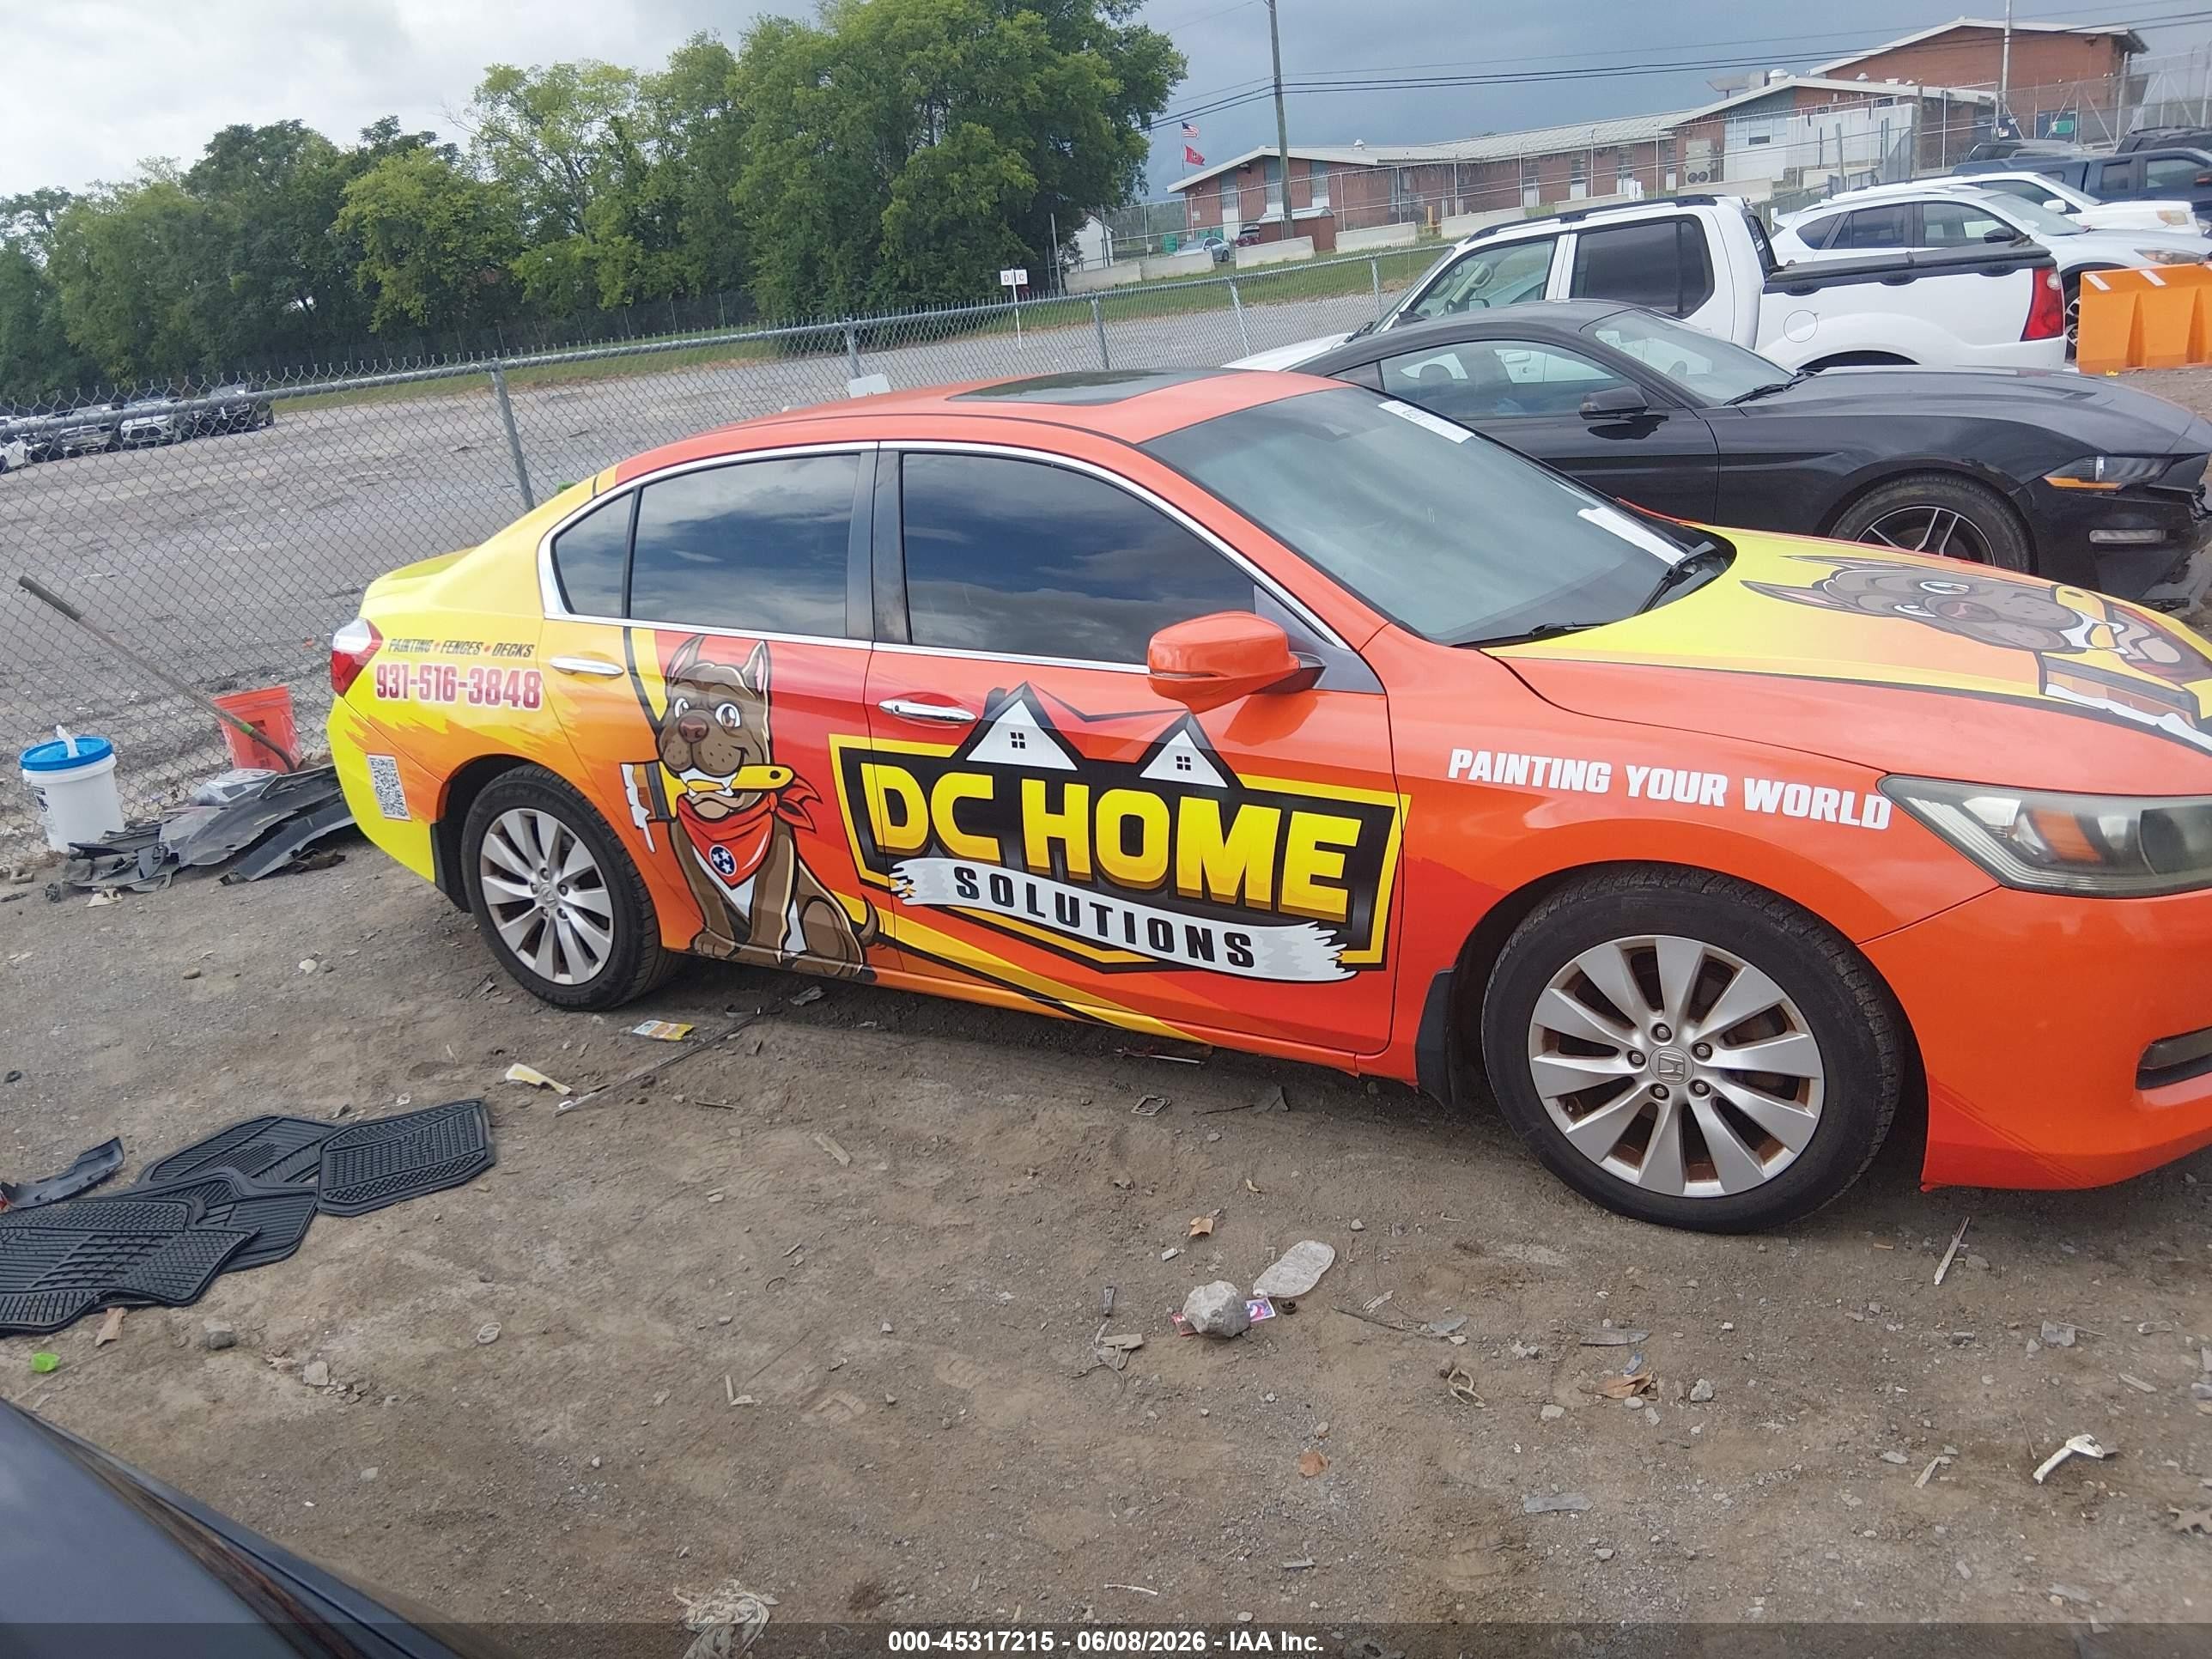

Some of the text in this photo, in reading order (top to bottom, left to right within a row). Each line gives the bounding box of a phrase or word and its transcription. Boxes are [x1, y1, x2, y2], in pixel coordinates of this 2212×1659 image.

[375, 664, 542, 710] 931-516-3848
[387, 638, 535, 659] PAINTING FENCES DECKS
[1447, 748, 1893, 830] PAINTING YOUR WORLD
[860, 762, 1362, 923] DC HOME
[953, 865, 1255, 969] SOLUTIONS
